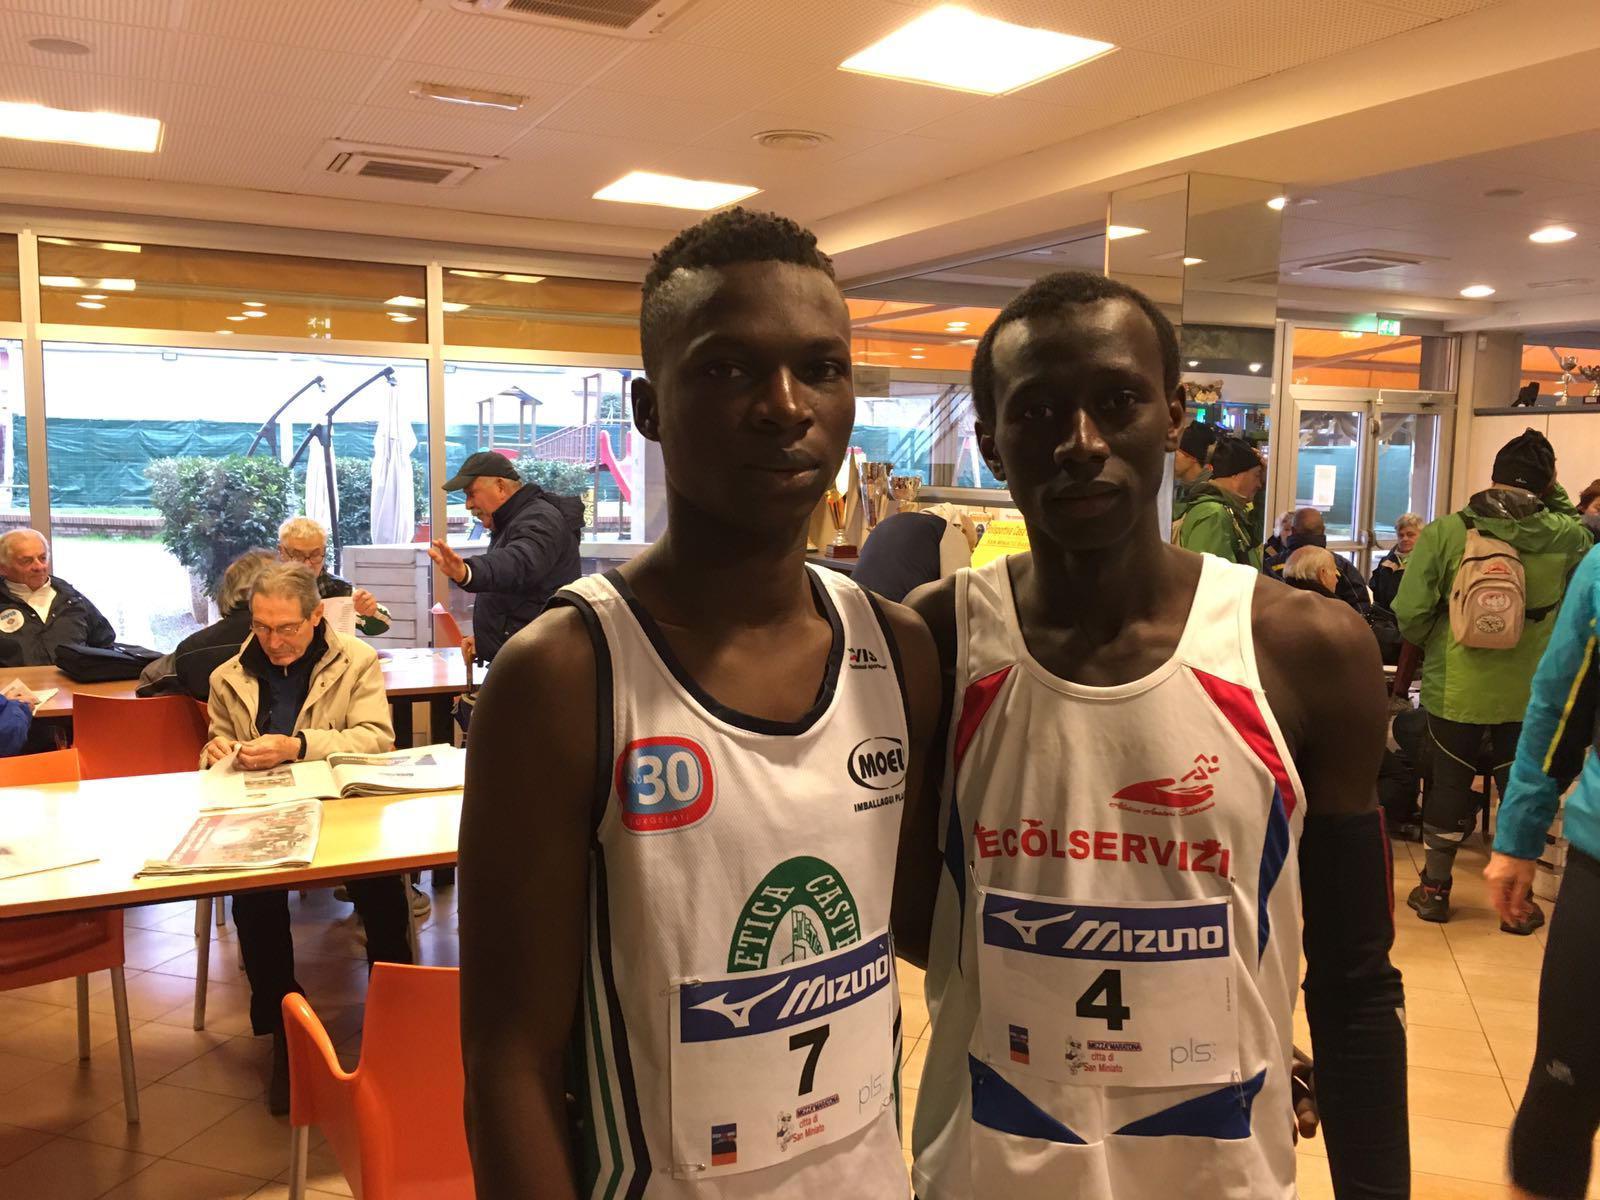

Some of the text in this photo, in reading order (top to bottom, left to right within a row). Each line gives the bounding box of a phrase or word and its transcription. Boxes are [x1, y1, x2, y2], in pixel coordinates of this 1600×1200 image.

[637, 751, 700, 806] 30
[1076, 969, 1131, 1031] 4
[789, 1024, 829, 1096] 7
[1084, 1063, 1123, 1073] San Miniato
[1108, 1053, 1114, 1062] di
